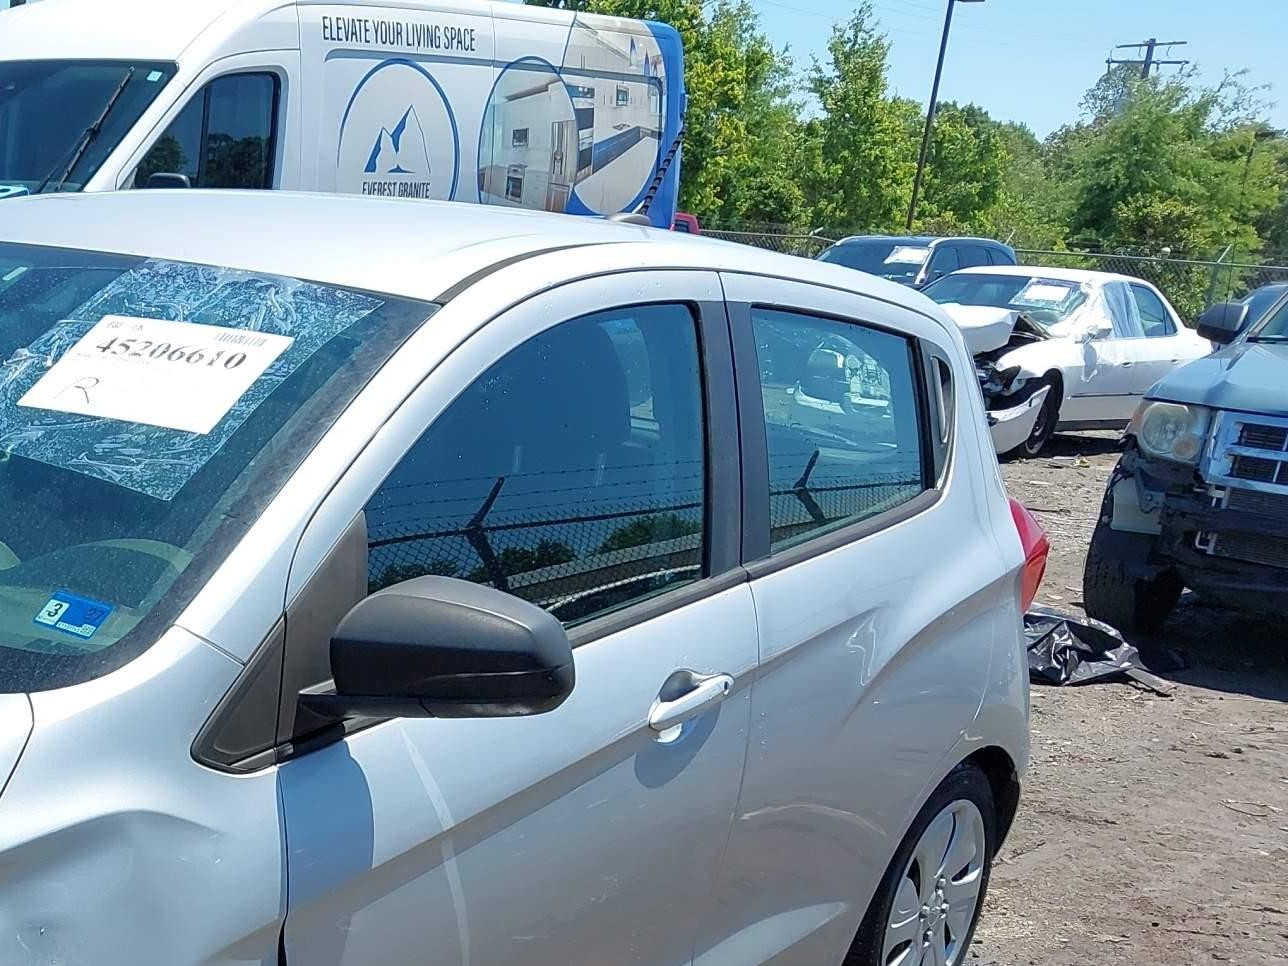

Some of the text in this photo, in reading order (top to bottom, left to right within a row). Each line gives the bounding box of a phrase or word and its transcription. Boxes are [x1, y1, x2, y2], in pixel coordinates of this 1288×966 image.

[322, 16, 476, 52] ELEVATE YOUR LIVING SPACE
[362, 181, 431, 199] EVEREST GRANITE
[96, 336, 248, 370] 45206610
[46, 602, 64, 618] 3
